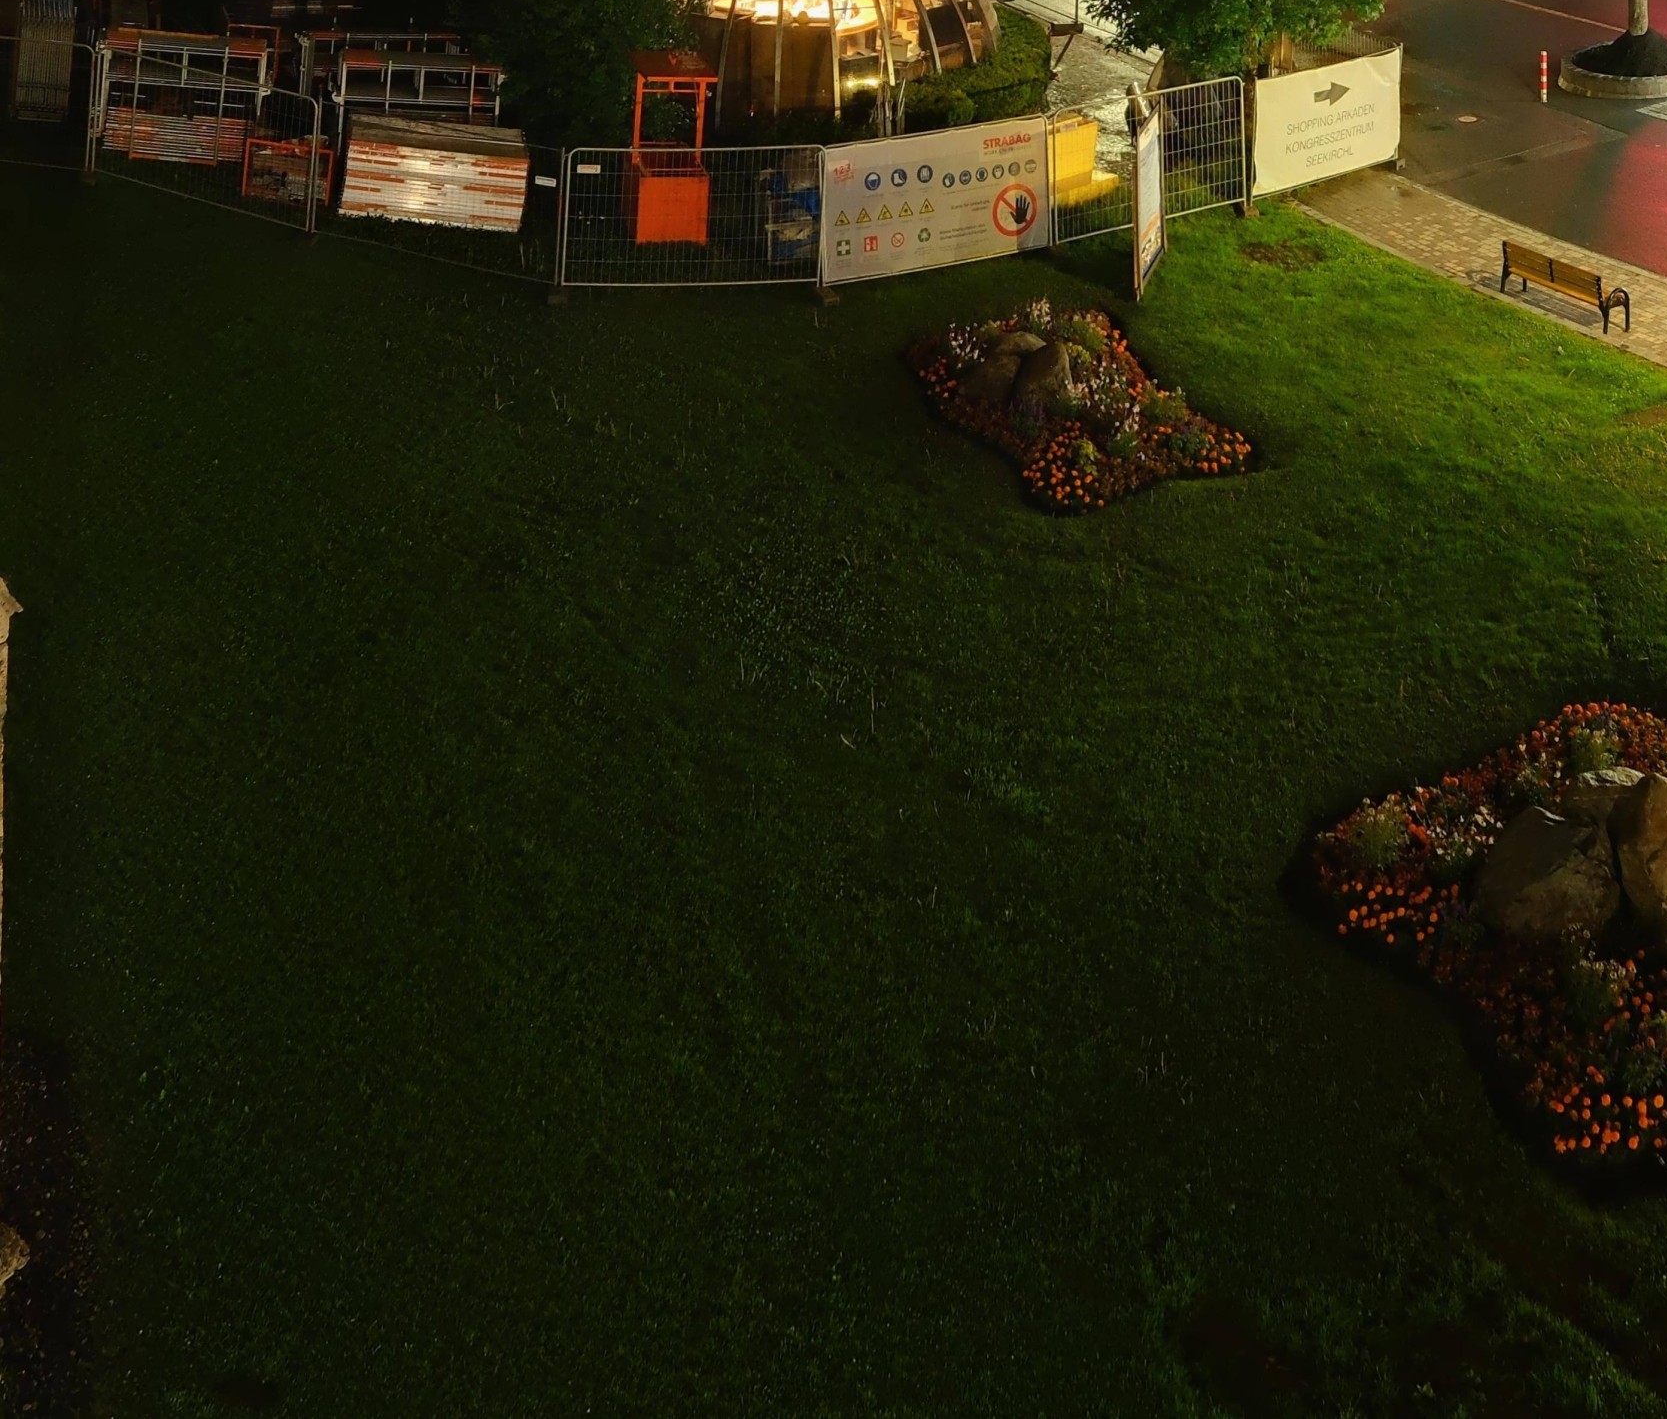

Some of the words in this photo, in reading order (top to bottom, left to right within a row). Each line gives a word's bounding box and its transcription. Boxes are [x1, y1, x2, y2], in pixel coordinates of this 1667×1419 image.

[1286, 114, 1334, 136] SHOPPING
[1336, 103, 1375, 122] ARKADEN
[983, 133, 1031, 150] STRABAG
[1285, 120, 1375, 155] KONGRESSZENTRUM
[1305, 145, 1354, 168] SEEKIRCHL
